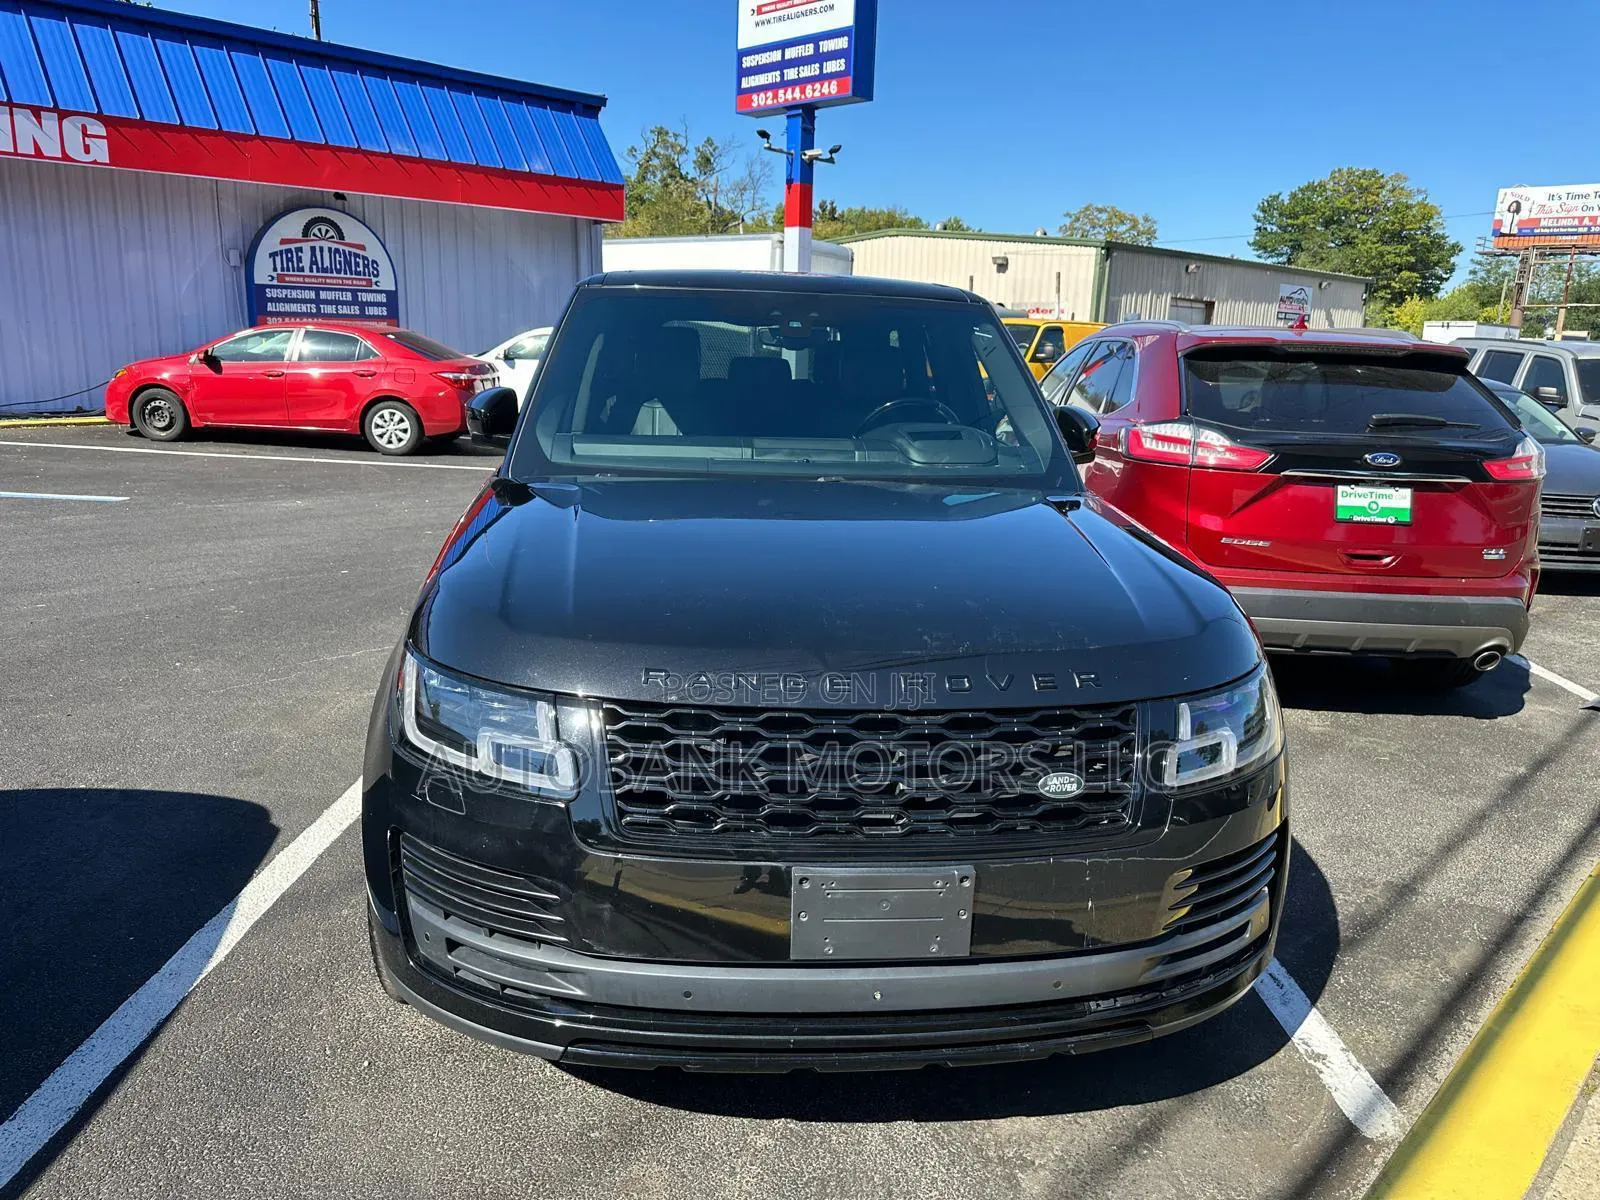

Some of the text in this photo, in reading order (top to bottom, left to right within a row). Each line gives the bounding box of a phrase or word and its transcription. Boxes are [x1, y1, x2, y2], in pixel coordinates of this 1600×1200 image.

[754, 4, 834, 28] WWW.TIREALIGNERS.COM
[742, 36, 848, 68] SUSPENSION MUFFLER TOWING
[741, 70, 780, 88] ALIGNMENTS
[823, 58, 845, 74] LUBES
[752, 80, 838, 107] 302.544.6246
[1548, 192, 1562, 201] It's
[1566, 192, 1590, 200] Time
[1556, 202, 1578, 216] Sign
[1581, 204, 1594, 212] On
[1540, 217, 1578, 226] MELINDA
[269, 246, 380, 278] TIRE ALIGNERS
[266, 288, 386, 302] SUSPENSION MUFFLER TOWING
[267, 303, 387, 315] ALIGNMENTS TIRE SALES LUBES
[1374, 456, 1394, 464] Ford
[1221, 537, 1272, 548] EDGE
[642, 667, 1102, 694] RANGE ROVER
[1047, 776, 1069, 785] LAND
[1050, 784, 1077, 792] ROVER
